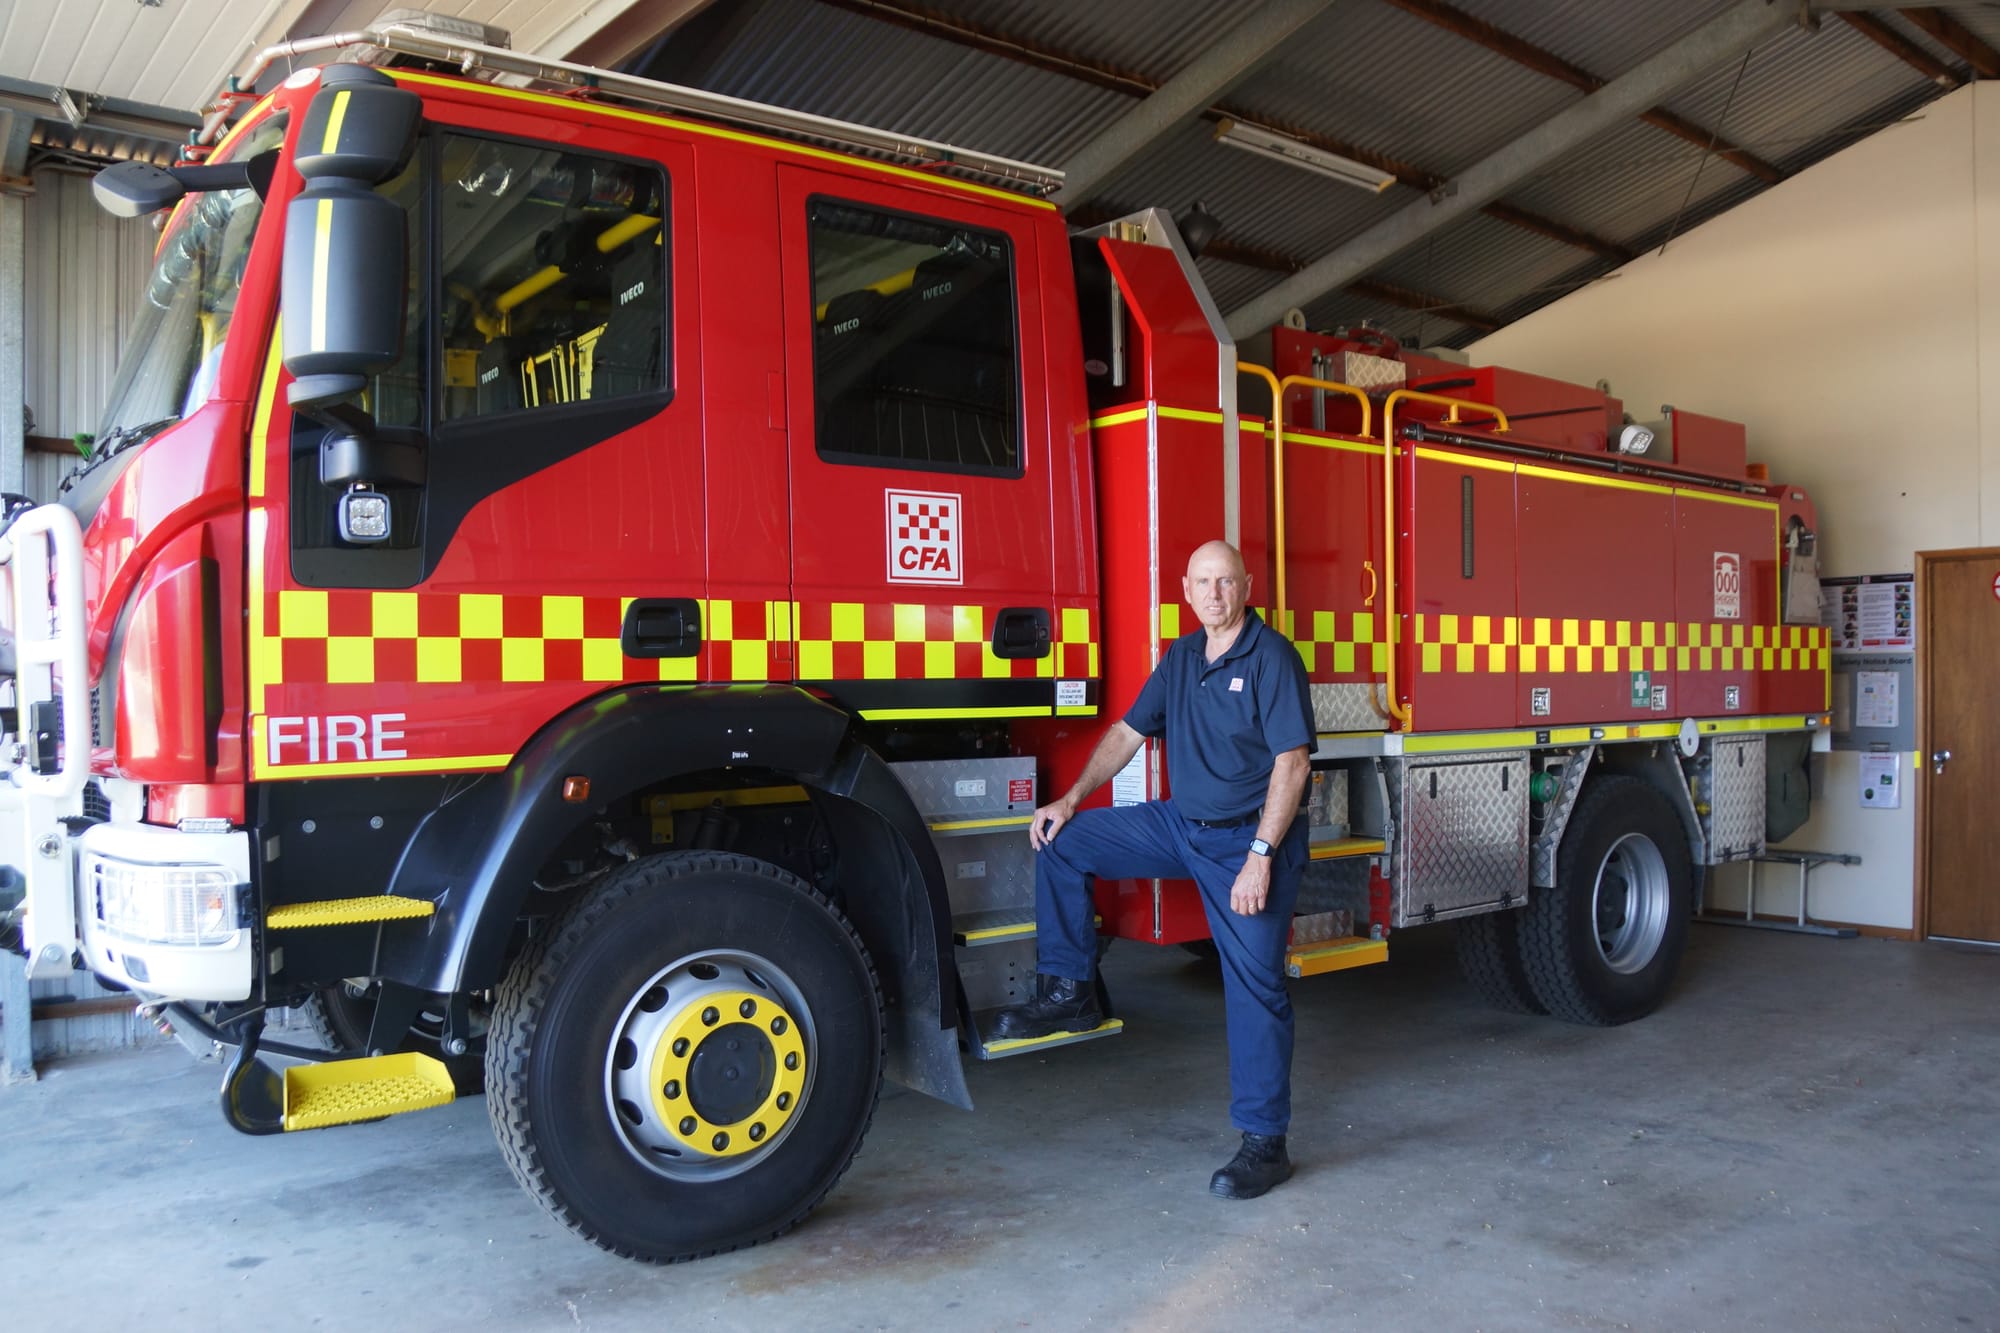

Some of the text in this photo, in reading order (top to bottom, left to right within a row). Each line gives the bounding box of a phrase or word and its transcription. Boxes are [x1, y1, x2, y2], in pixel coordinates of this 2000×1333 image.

[620, 281, 645, 306] IVECO
[922, 281, 952, 301] IVECO
[833, 317, 860, 336] IVECO
[481, 366, 500, 384] IVECO
[898, 545, 951, 571] CFA
[1716, 572, 1738, 593] 000
[269, 713, 407, 764] FIRE
